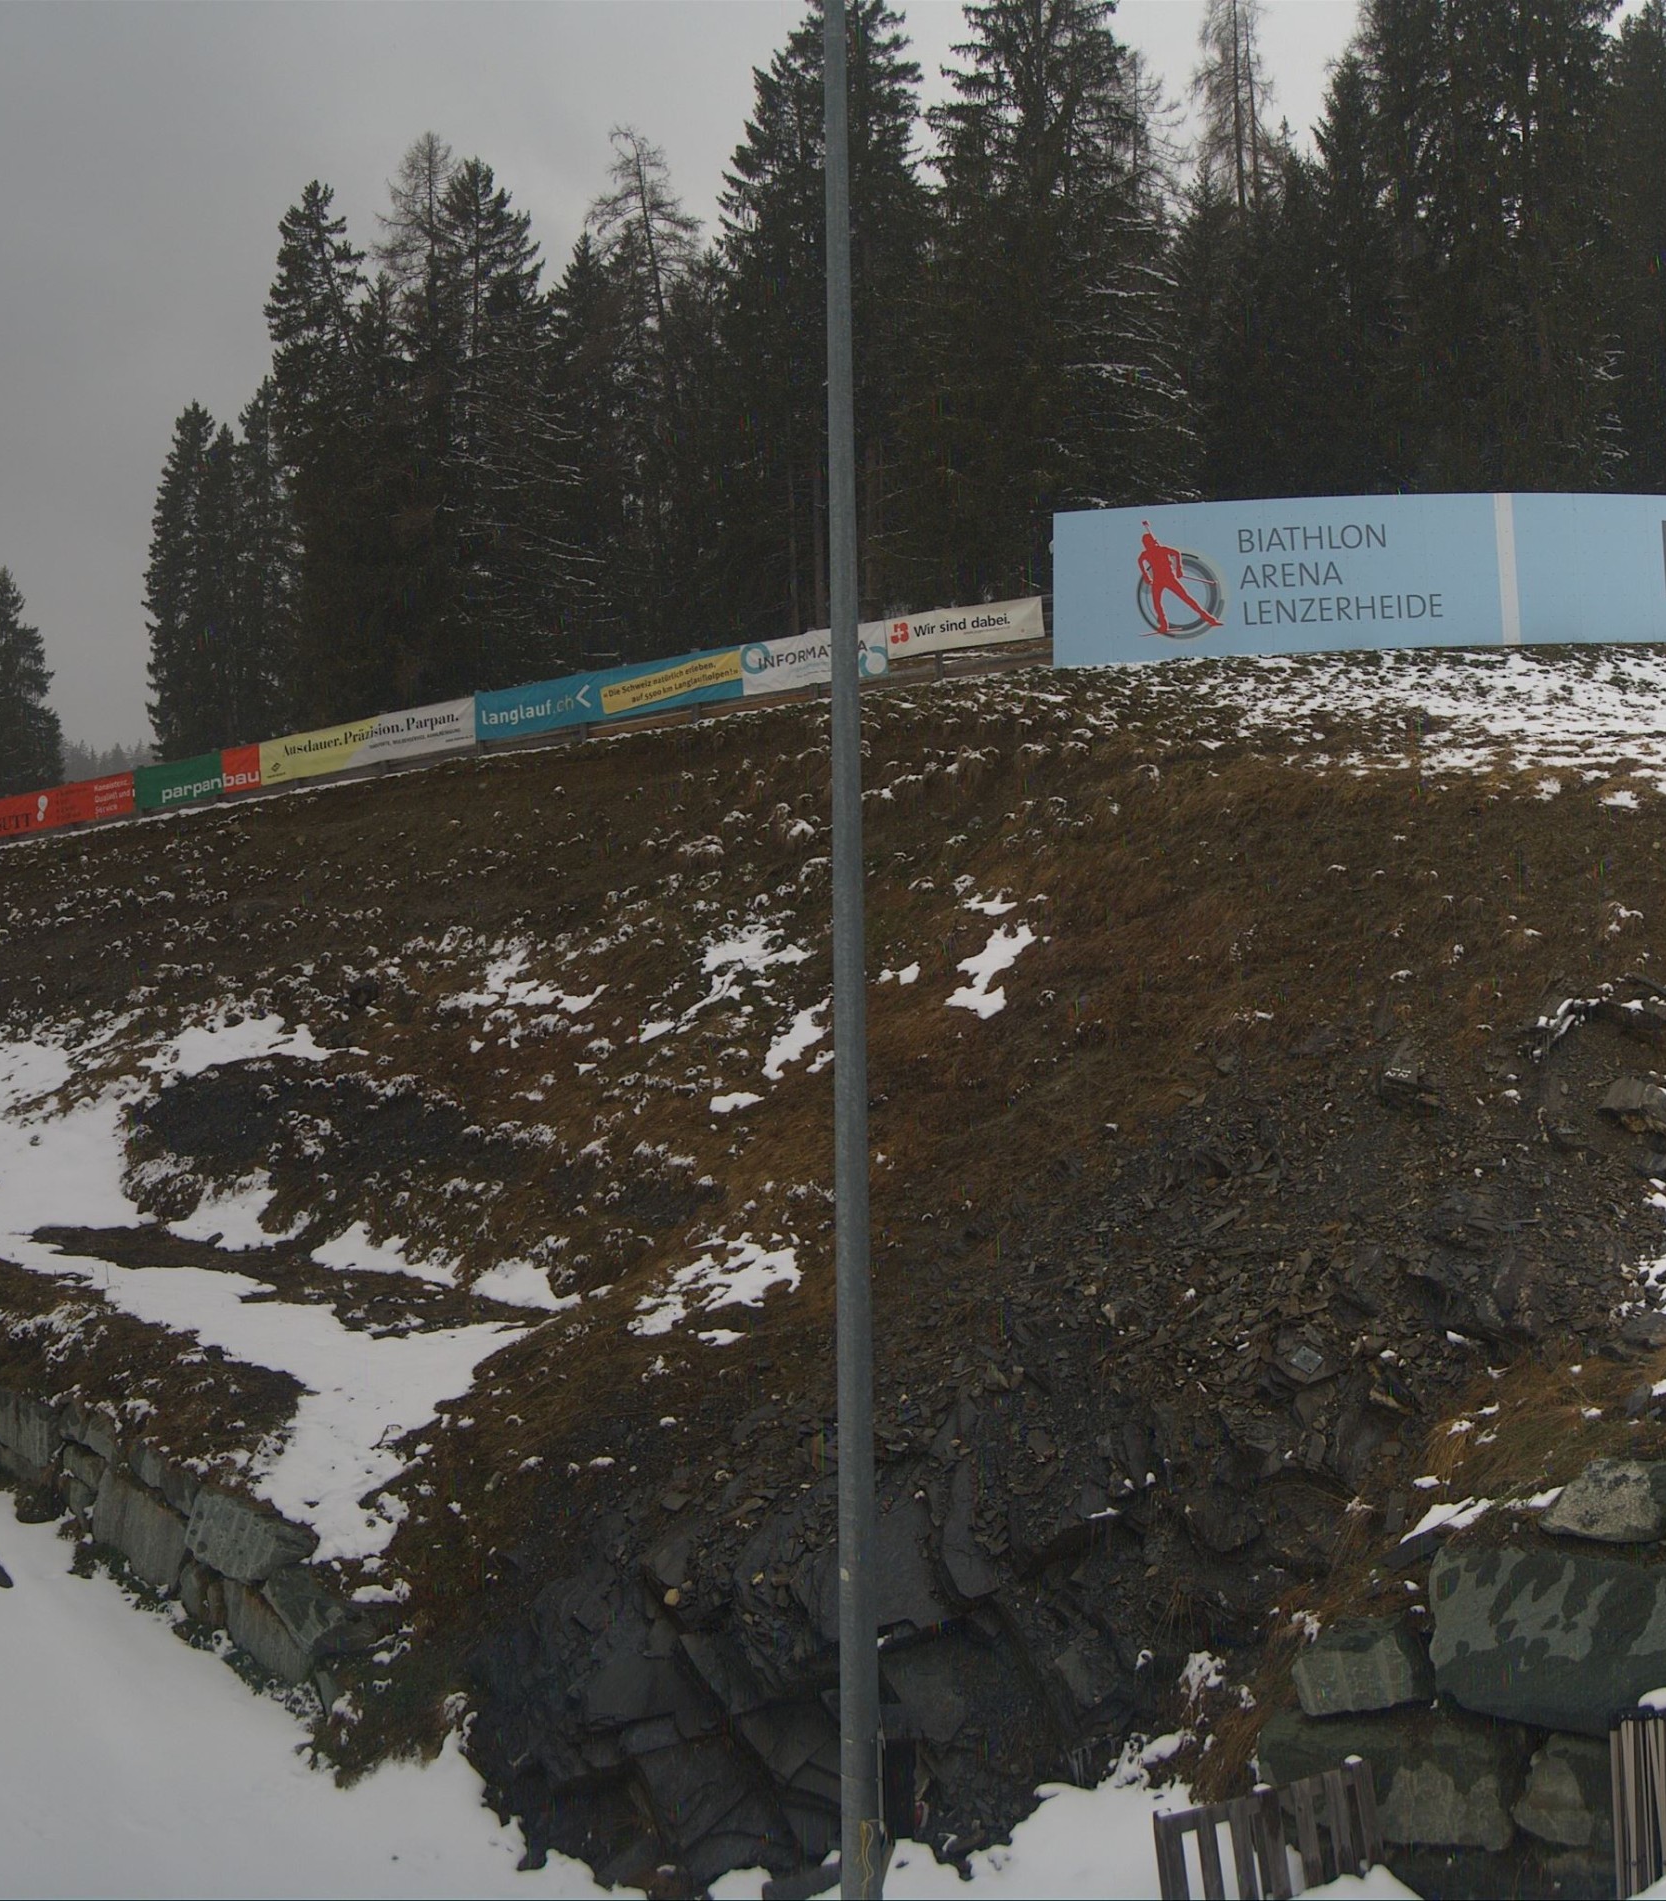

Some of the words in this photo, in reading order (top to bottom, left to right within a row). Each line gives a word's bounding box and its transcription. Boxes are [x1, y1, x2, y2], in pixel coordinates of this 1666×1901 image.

[1237, 523, 1387, 553] BIATHLON
[1240, 561, 1343, 590] ARENA
[1243, 593, 1444, 626] LENZERHEIDE
[913, 623, 936, 638] Wir
[939, 617, 967, 633] sind
[971, 612, 1011, 629] dabei.
[622, 681, 652, 693] Schweiz
[653, 670, 684, 685] natürlich
[645, 689, 662, 701] 5500
[663, 685, 673, 695] km
[482, 693, 575, 726] langlauf.ch
[283, 737, 342, 757] Ausdauer.
[344, 723, 404, 744] Präzision.
[406, 712, 459, 731] Parpan.
[118, 789, 131, 798] und
[161, 771, 260, 803] parpanbau
[95, 803, 118, 814] Service
